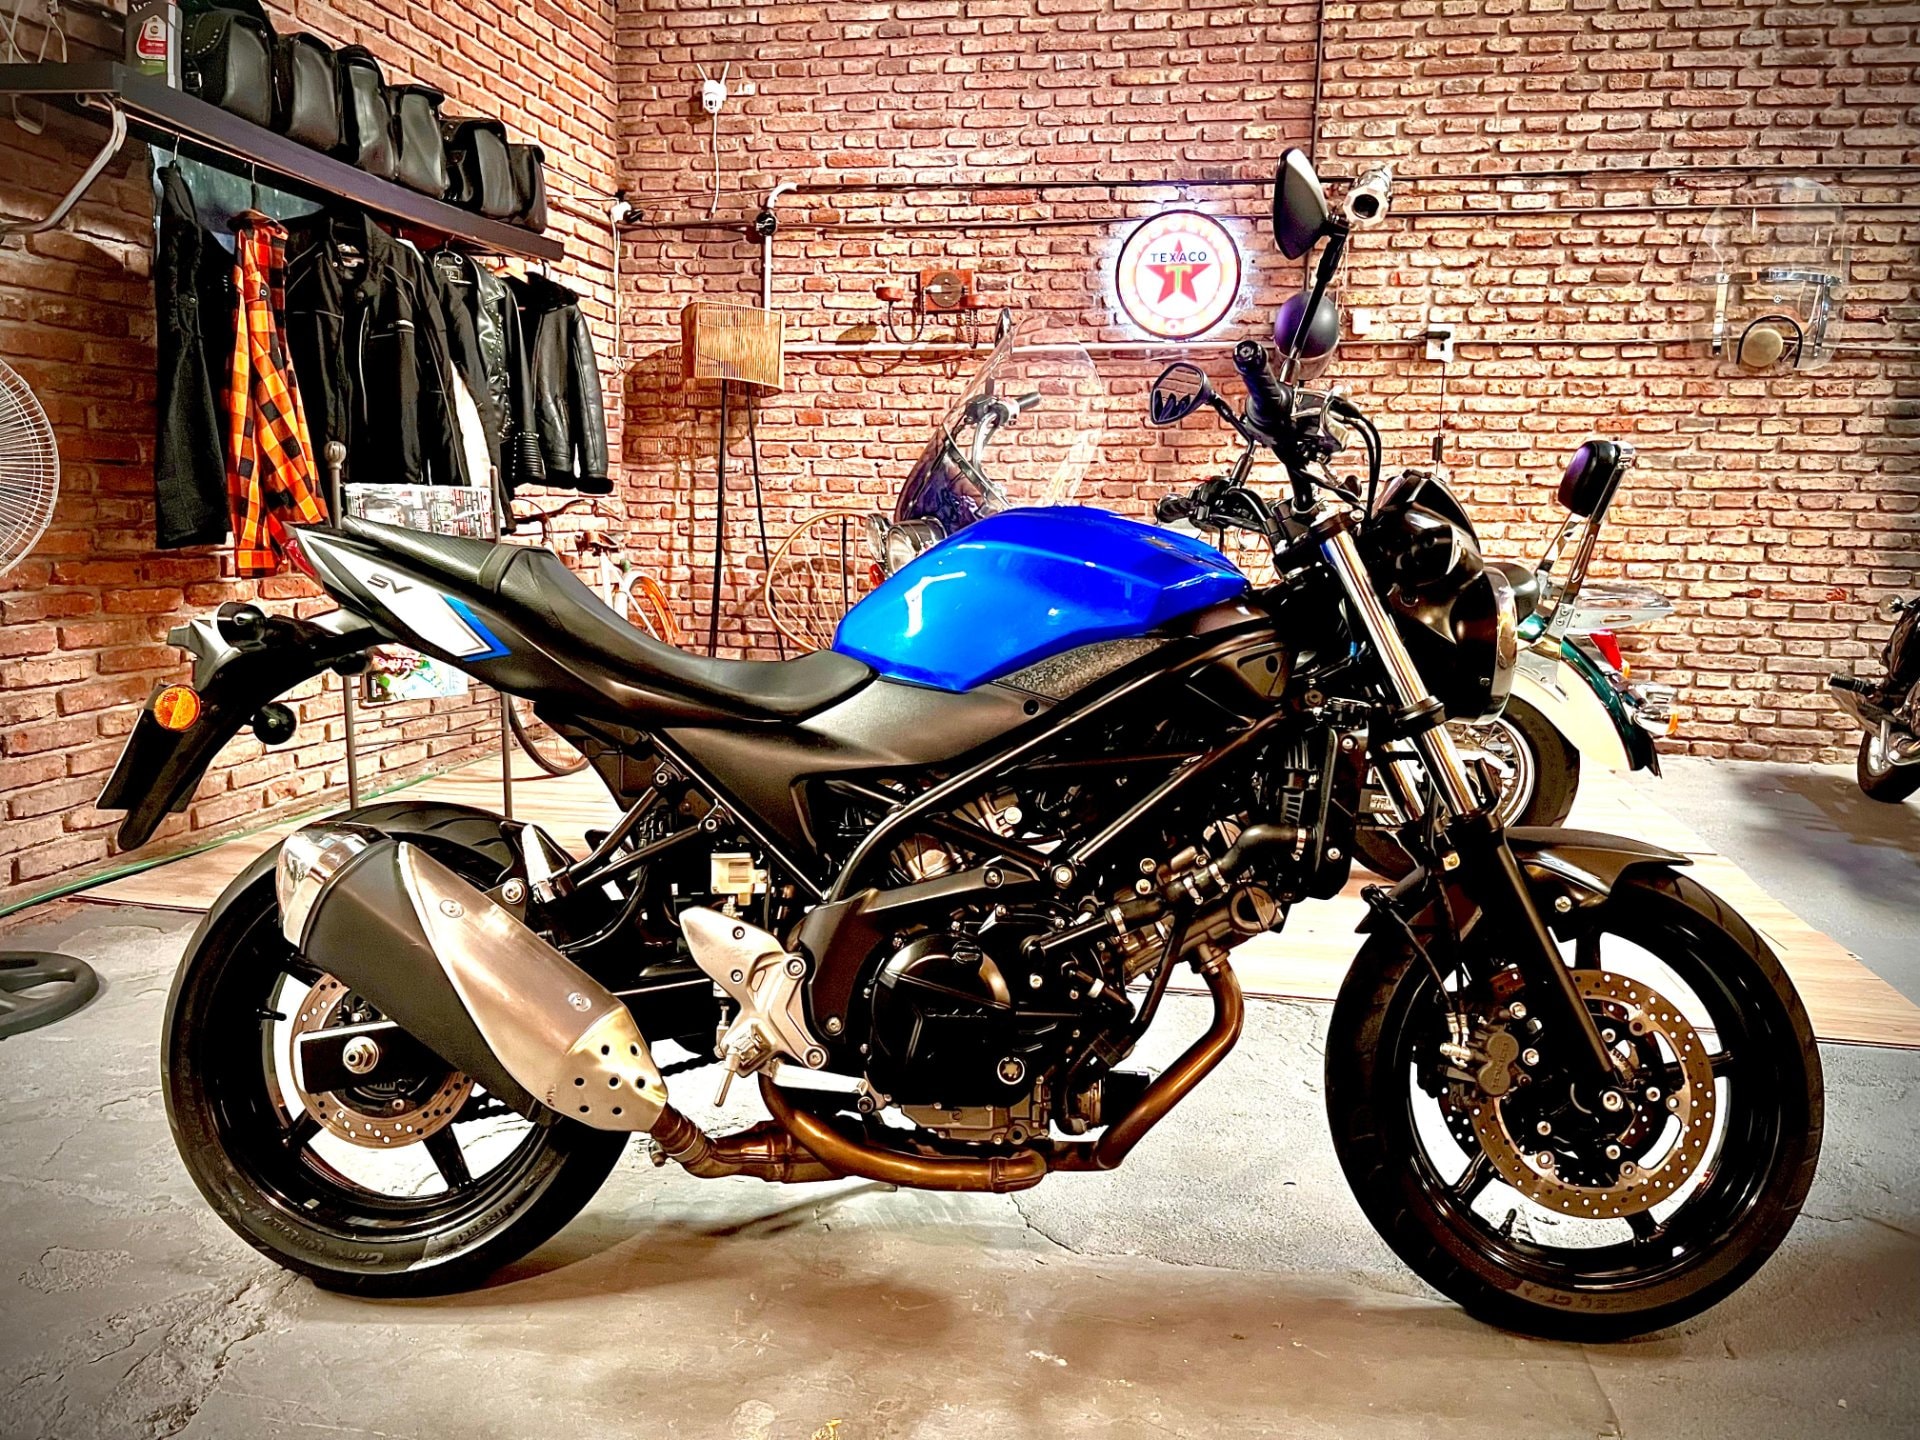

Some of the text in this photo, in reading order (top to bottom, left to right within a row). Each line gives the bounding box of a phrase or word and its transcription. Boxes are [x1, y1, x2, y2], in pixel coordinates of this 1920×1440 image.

[1151, 251, 1207, 263] TEXACO
[1165, 265, 1193, 290] T
[367, 572, 413, 594] SV
